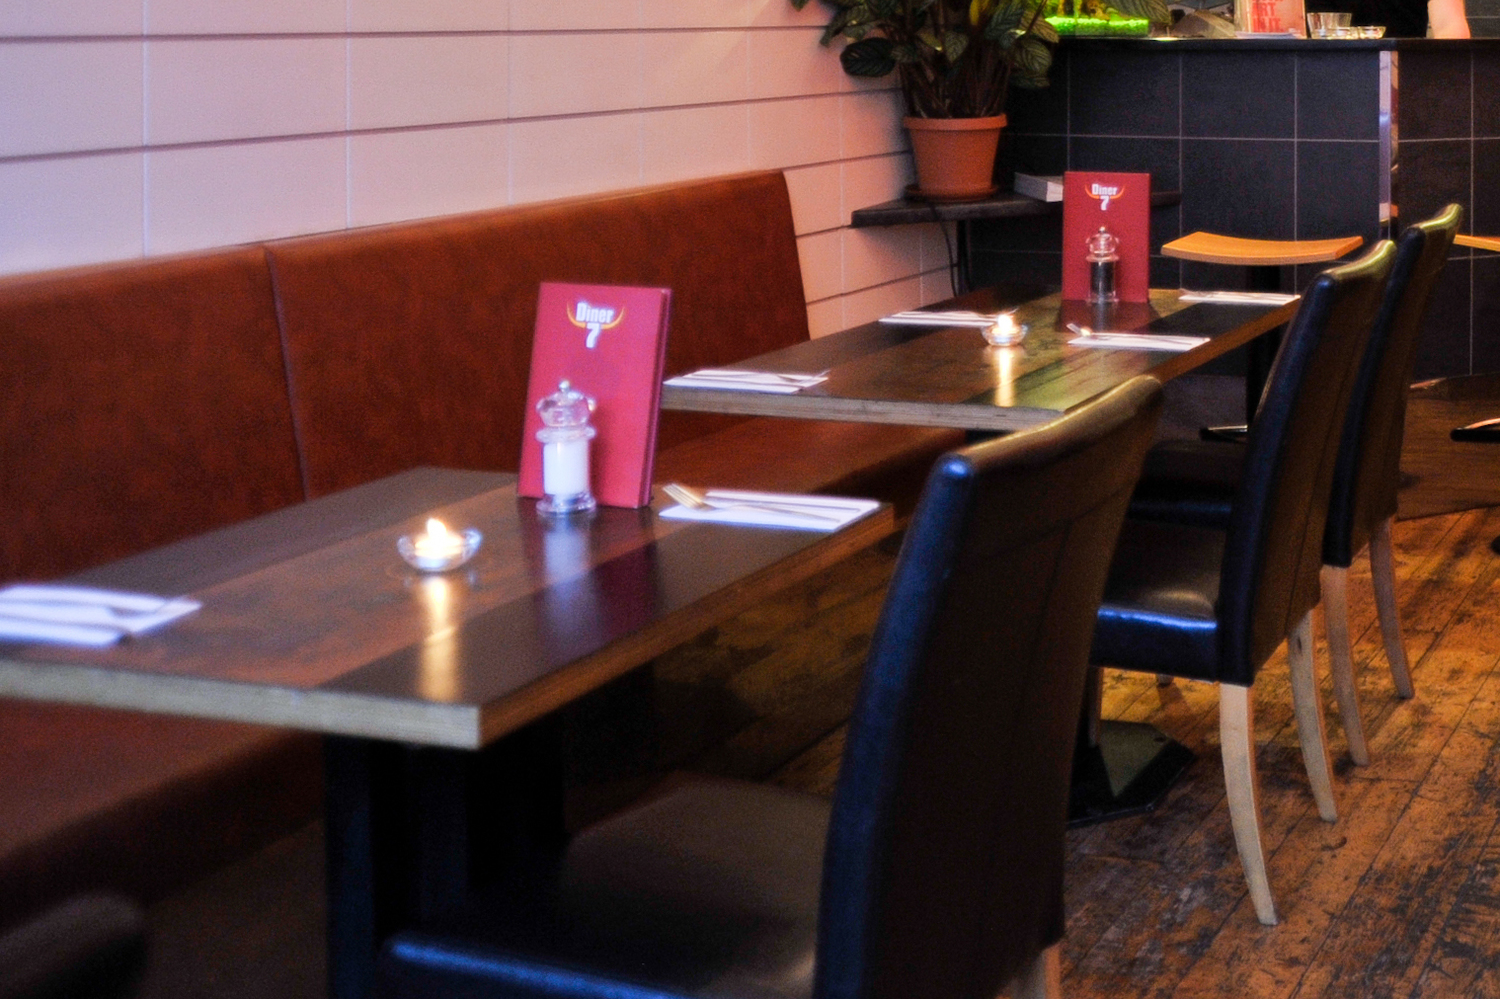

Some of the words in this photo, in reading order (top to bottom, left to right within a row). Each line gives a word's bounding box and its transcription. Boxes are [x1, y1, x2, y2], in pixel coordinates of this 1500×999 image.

[1251, 3, 1276, 17] ART
[1092, 183, 1118, 195] Diner
[1100, 195, 1110, 211] 7
[576, 302, 615, 324] Diner
[586, 322, 600, 348] 7
